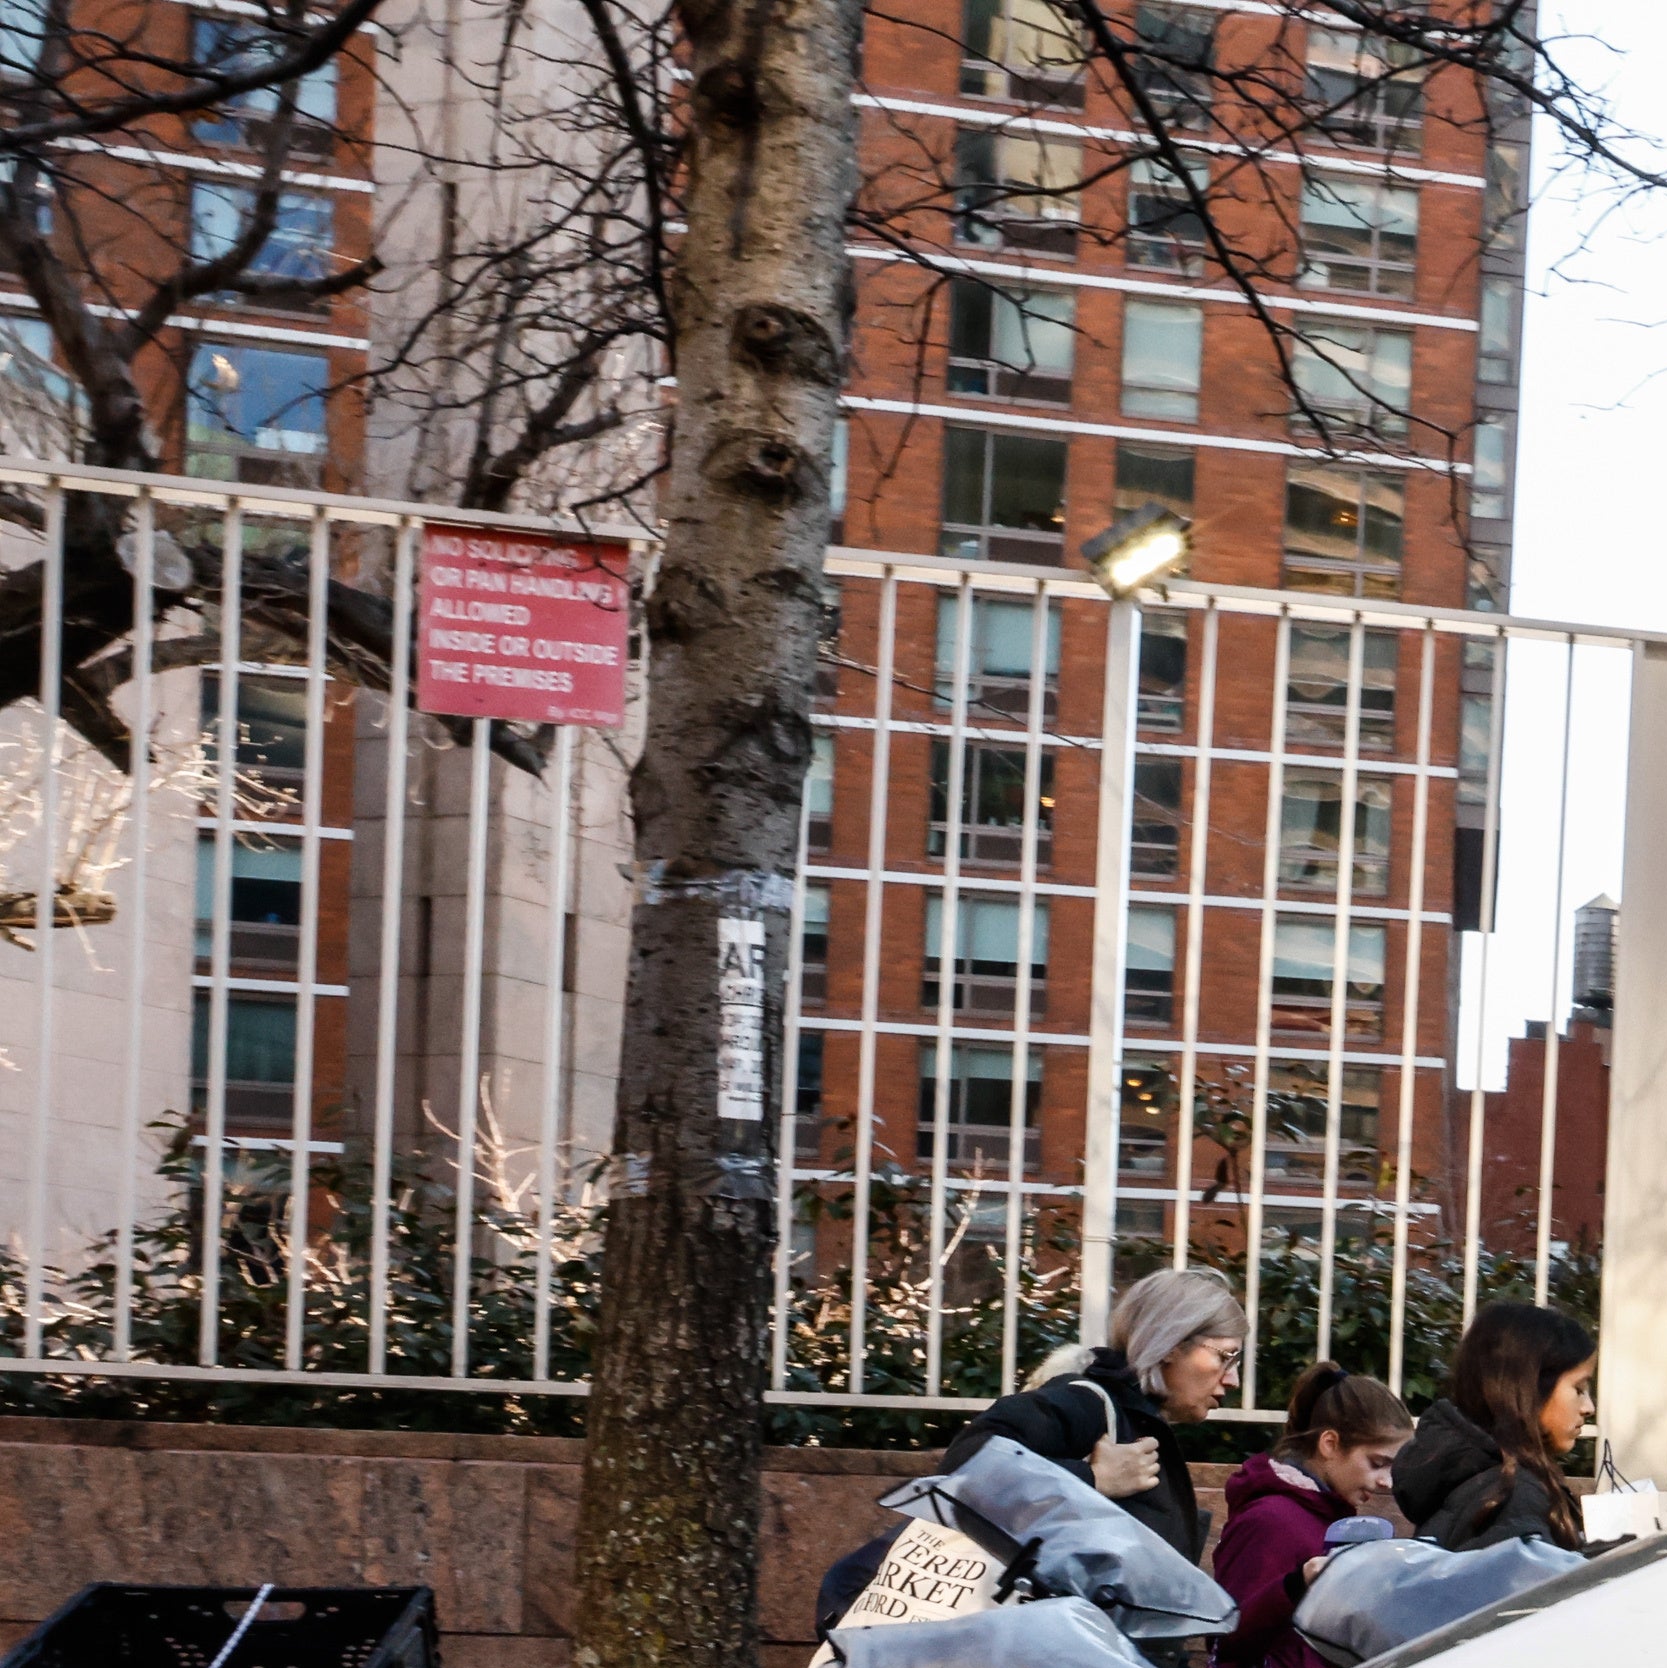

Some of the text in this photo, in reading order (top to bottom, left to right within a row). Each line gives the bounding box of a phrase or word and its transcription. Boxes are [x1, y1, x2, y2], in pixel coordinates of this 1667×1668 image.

[430, 566, 463, 588] OR
[465, 568, 507, 593] PAN
[429, 597, 532, 626] ALLOWED
[429, 628, 619, 666] INSIDE OR OUTSIDE
[428, 659, 574, 693] THE PREMISES
[917, 1529, 946, 1551] THE
